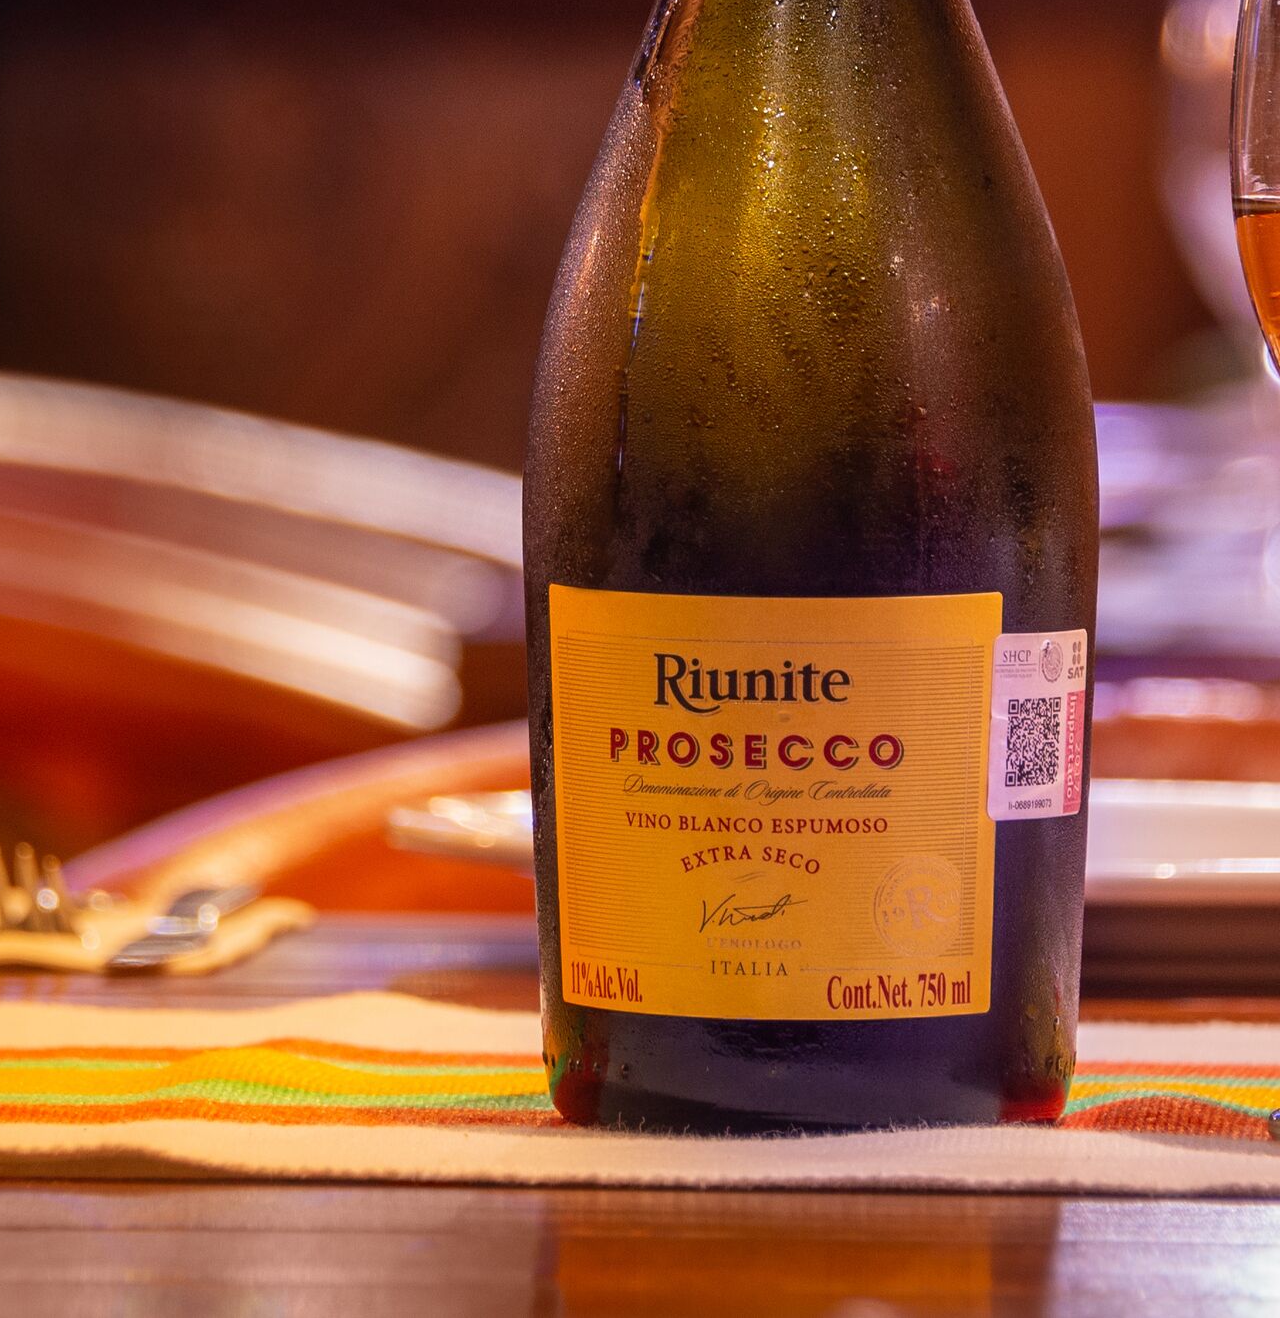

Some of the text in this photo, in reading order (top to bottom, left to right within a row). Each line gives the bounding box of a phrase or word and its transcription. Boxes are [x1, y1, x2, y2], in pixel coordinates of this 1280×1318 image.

[1002, 650, 1032, 663] SHCP
[653, 653, 853, 715] Riunite
[1067, 666, 1085, 680] SAT
[610, 727, 905, 771] PROSECCO
[1066, 695, 1078, 799] Importado
[622, 773, 893, 807] Denominazione di Origine Controllata
[625, 812, 889, 835] VINO BLANCO ESPUMOSO
[680, 844, 821, 875] EXTRA SECO
[711, 960, 788, 976] ITALIA
[917, 971, 947, 1007] 750
[951, 970, 972, 1005] ml
